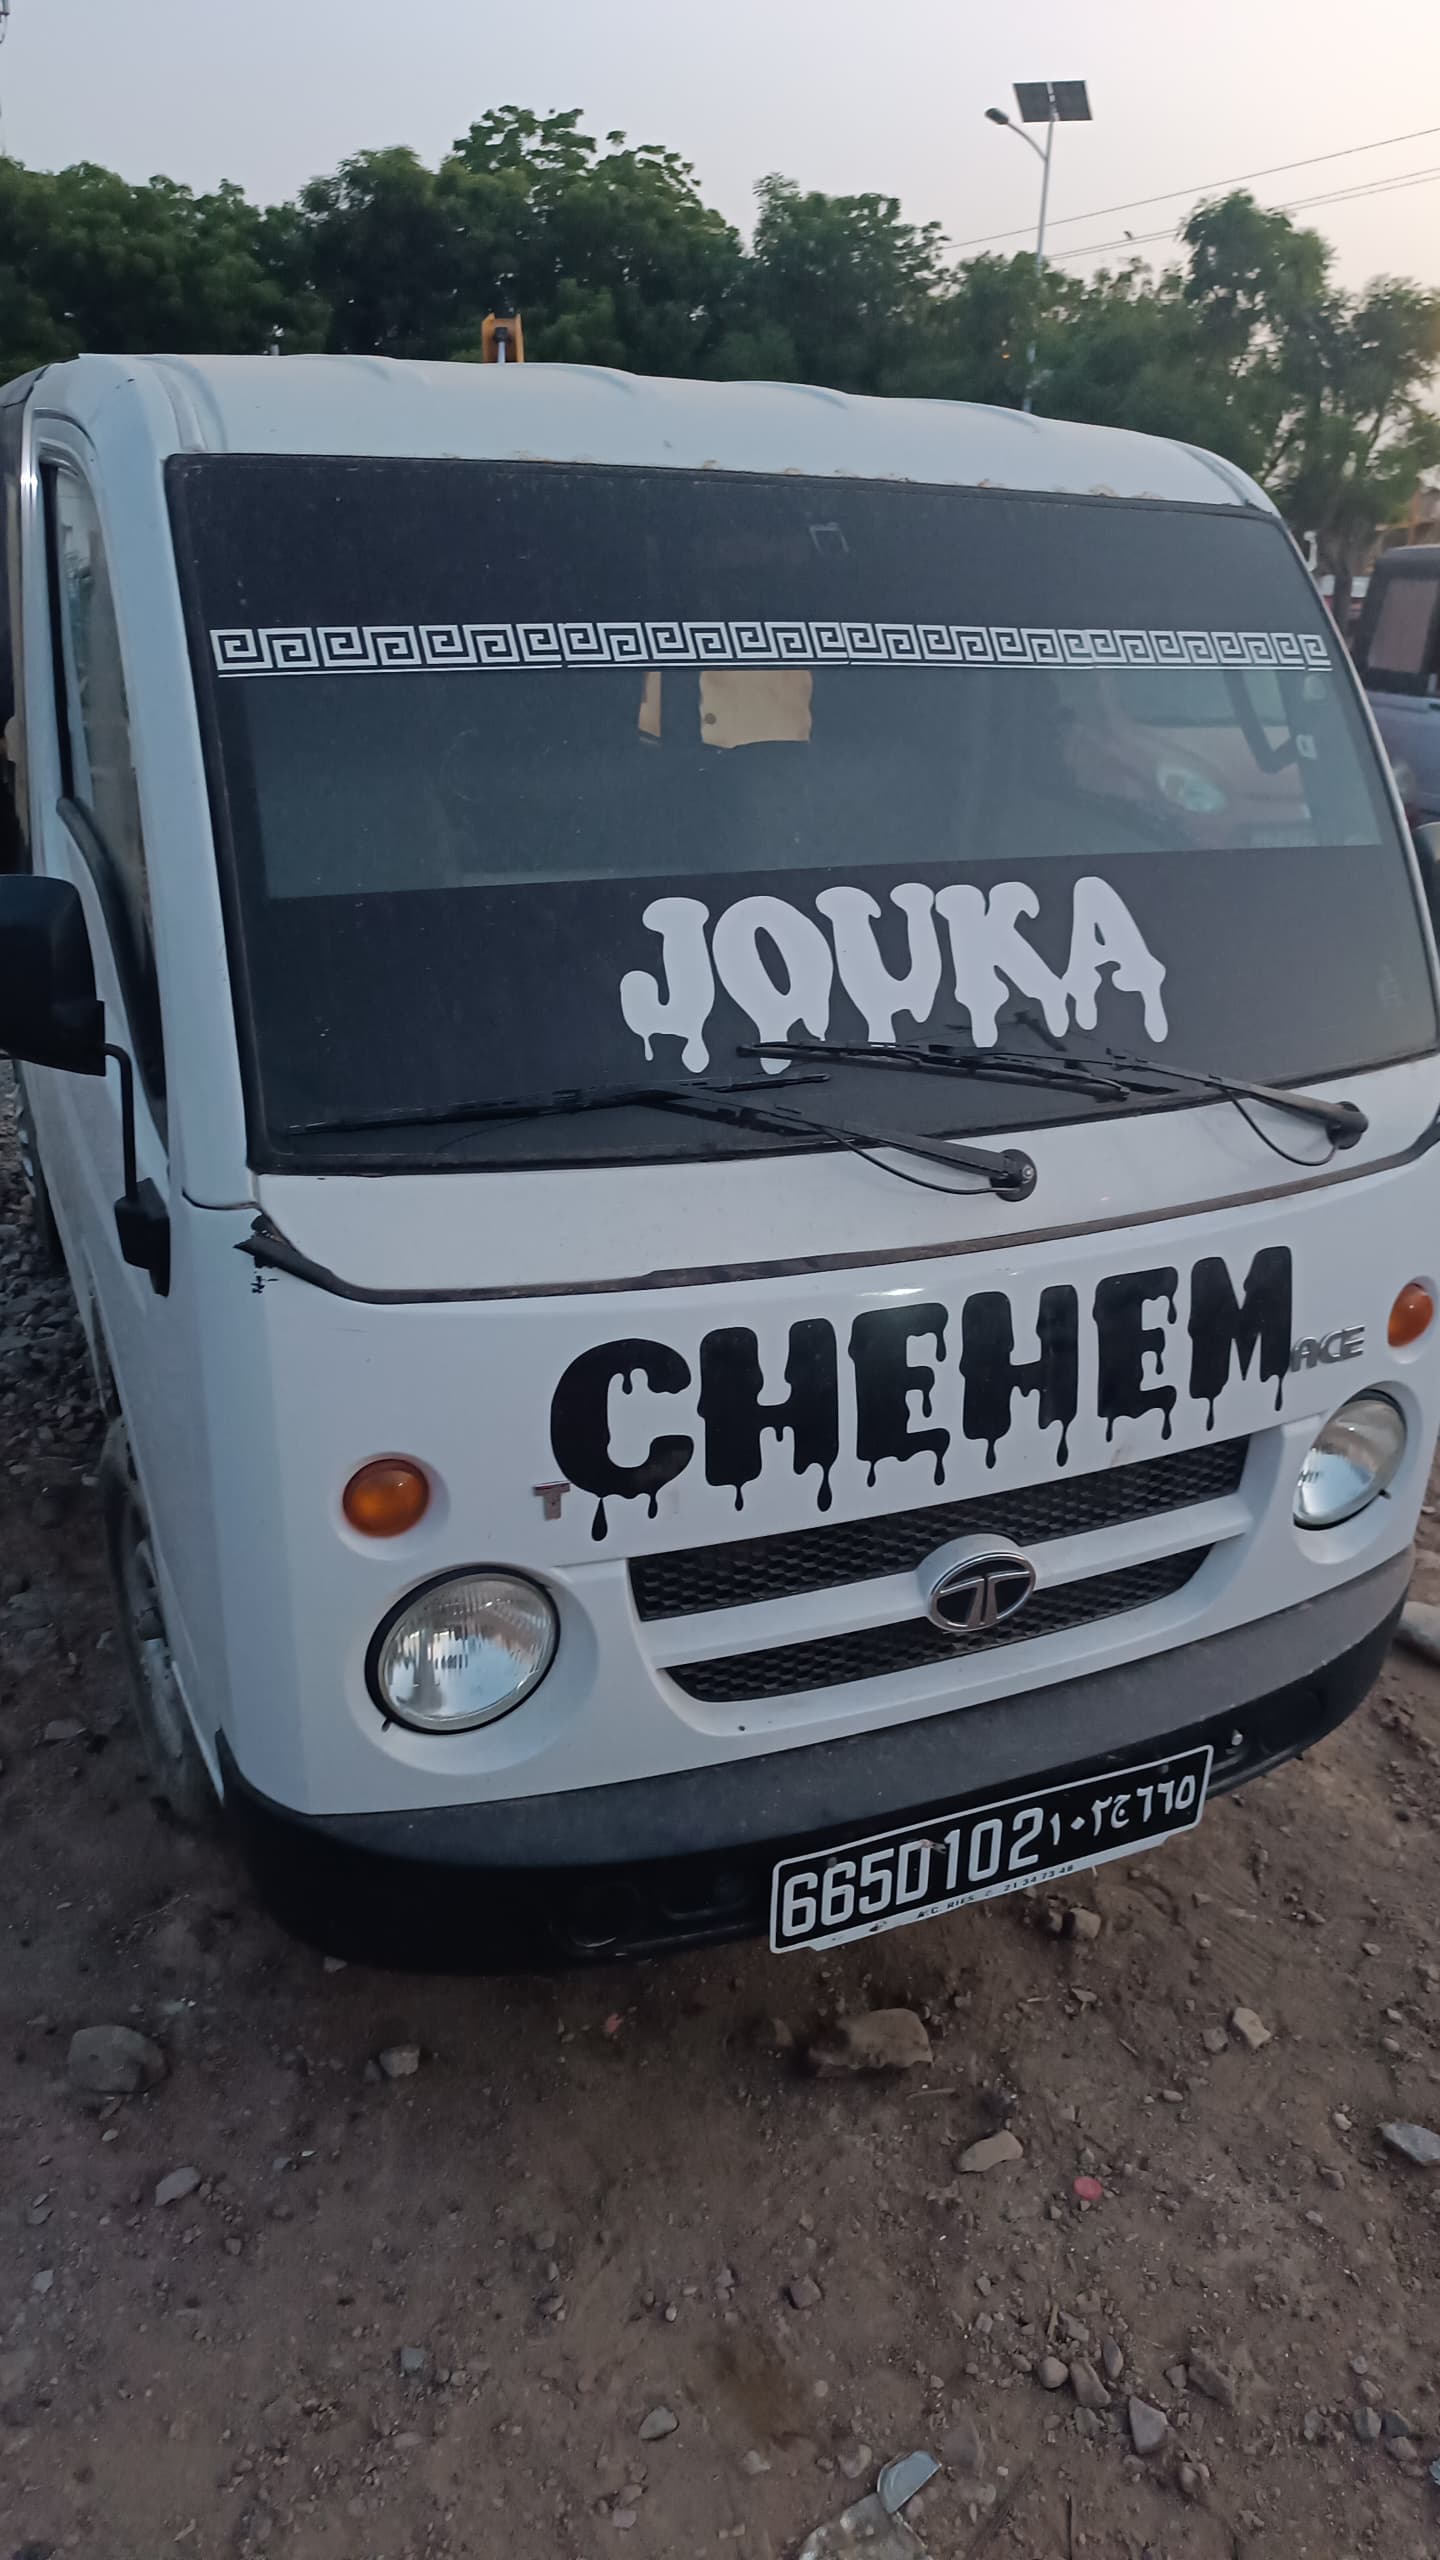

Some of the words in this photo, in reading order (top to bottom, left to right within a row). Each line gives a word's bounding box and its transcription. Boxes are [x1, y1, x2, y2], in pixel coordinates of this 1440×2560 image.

[620, 876, 1168, 1074] JOUKA
[550, 1246, 1292, 1541] CHEHEM
[1290, 1325, 1365, 1372] ACE
[781, 1807, 1044, 1937] 665D102
